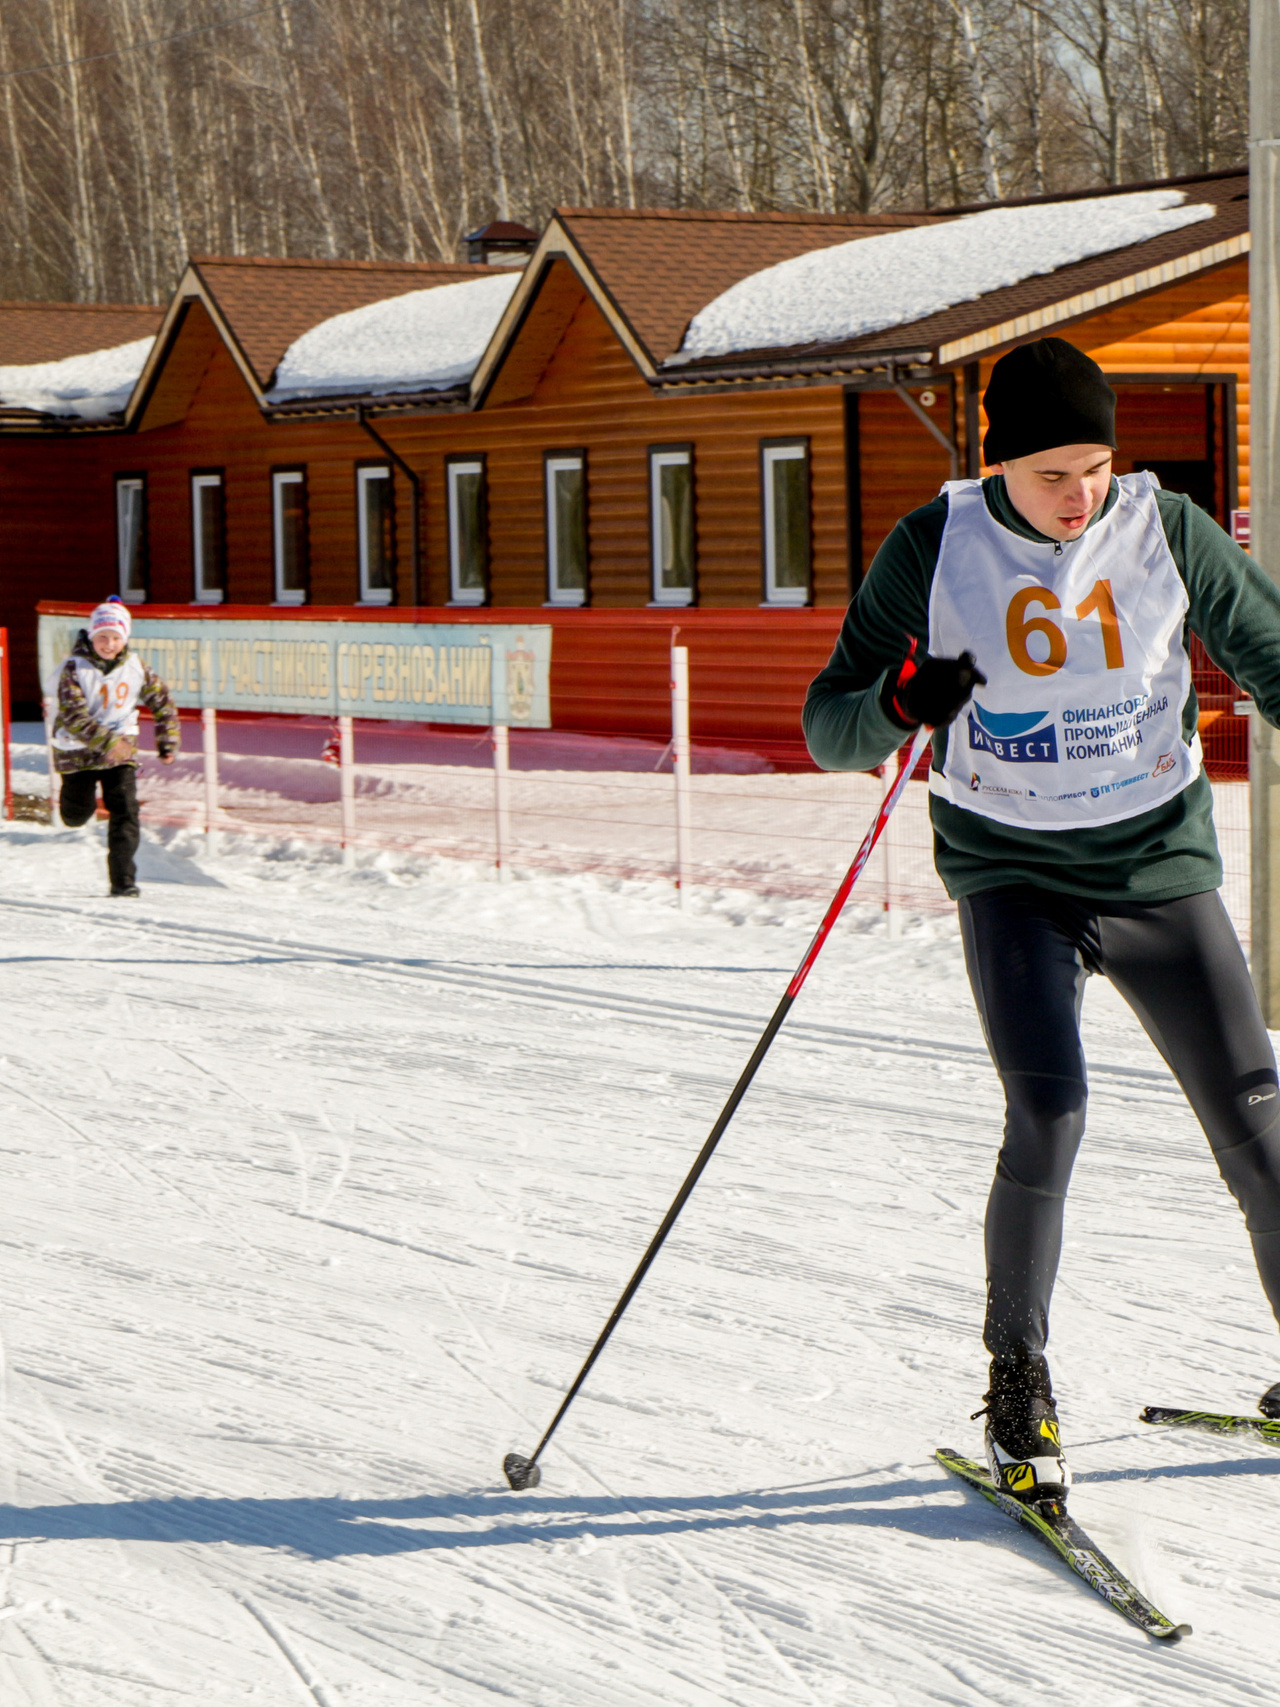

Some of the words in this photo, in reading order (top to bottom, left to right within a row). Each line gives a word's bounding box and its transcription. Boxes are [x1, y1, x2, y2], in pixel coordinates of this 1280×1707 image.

[1006, 578, 1125, 677] 61
[99, 682, 130, 709] 19
[216, 638, 331, 699] УЧАСТНИКОВ
[337, 633, 492, 707] СОРЕВНОВАНИЙ
[1066, 729, 1143, 760] КОМПАНИЯ
